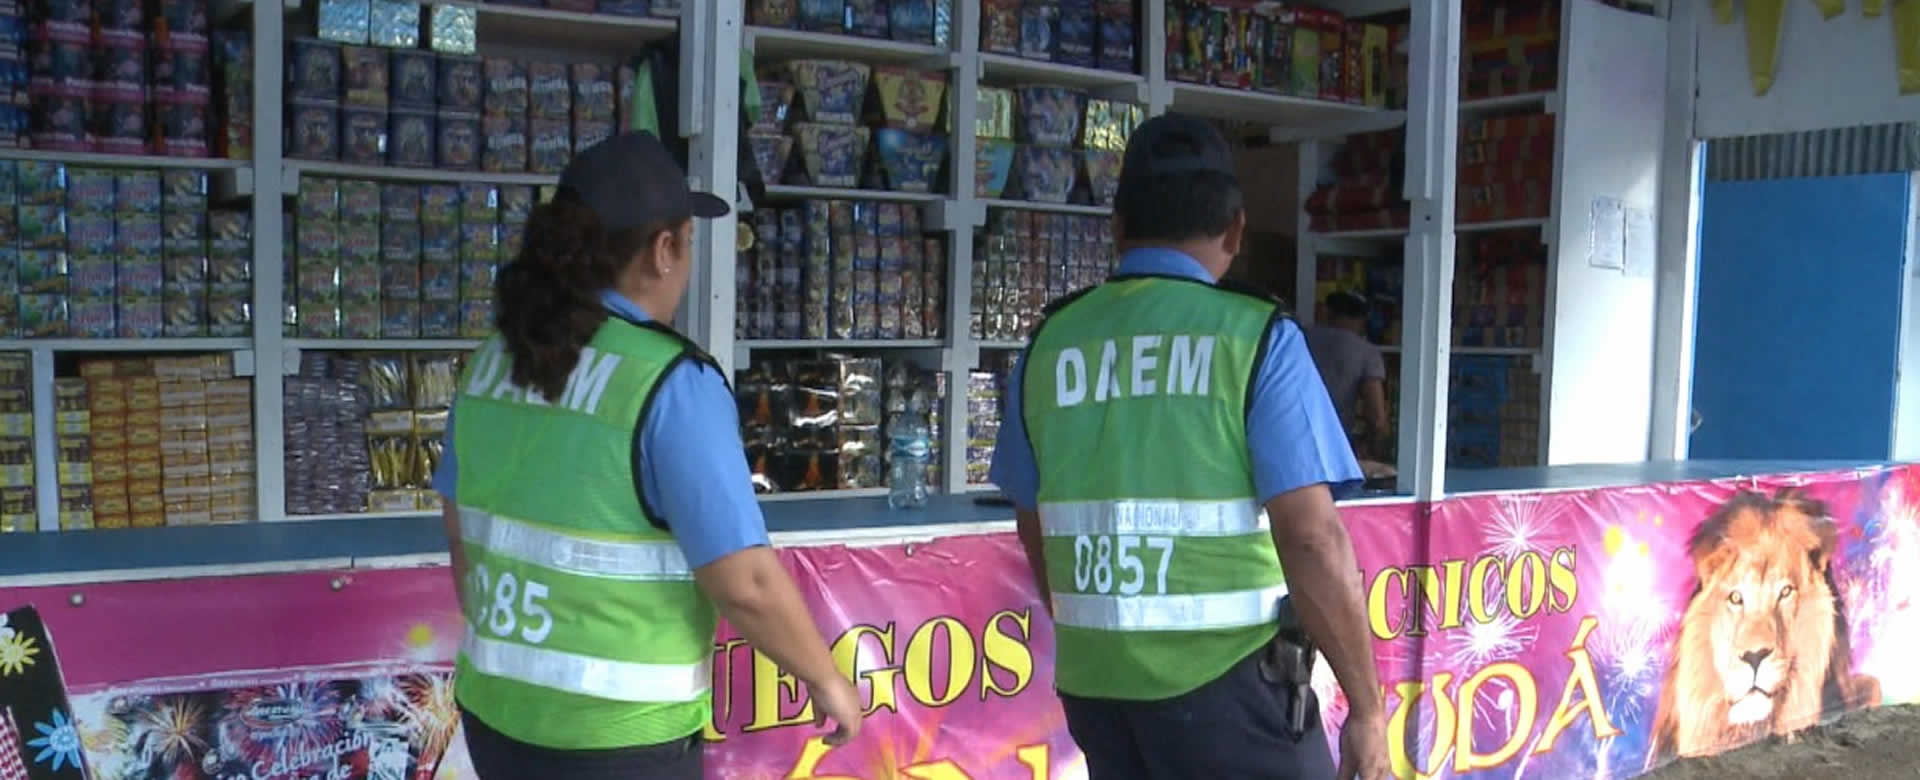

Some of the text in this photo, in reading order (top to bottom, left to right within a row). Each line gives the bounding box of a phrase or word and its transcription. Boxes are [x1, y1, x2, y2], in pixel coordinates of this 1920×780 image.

[465, 336, 624, 416] DAM
[1055, 334, 1217, 408] DAEM
[1074, 534, 1175, 595] 0857
[702, 543, 1578, 743] UEGOS CNICOS
[1381, 614, 1625, 780] UDÁ
[251, 728, 375, 780] Celebración
